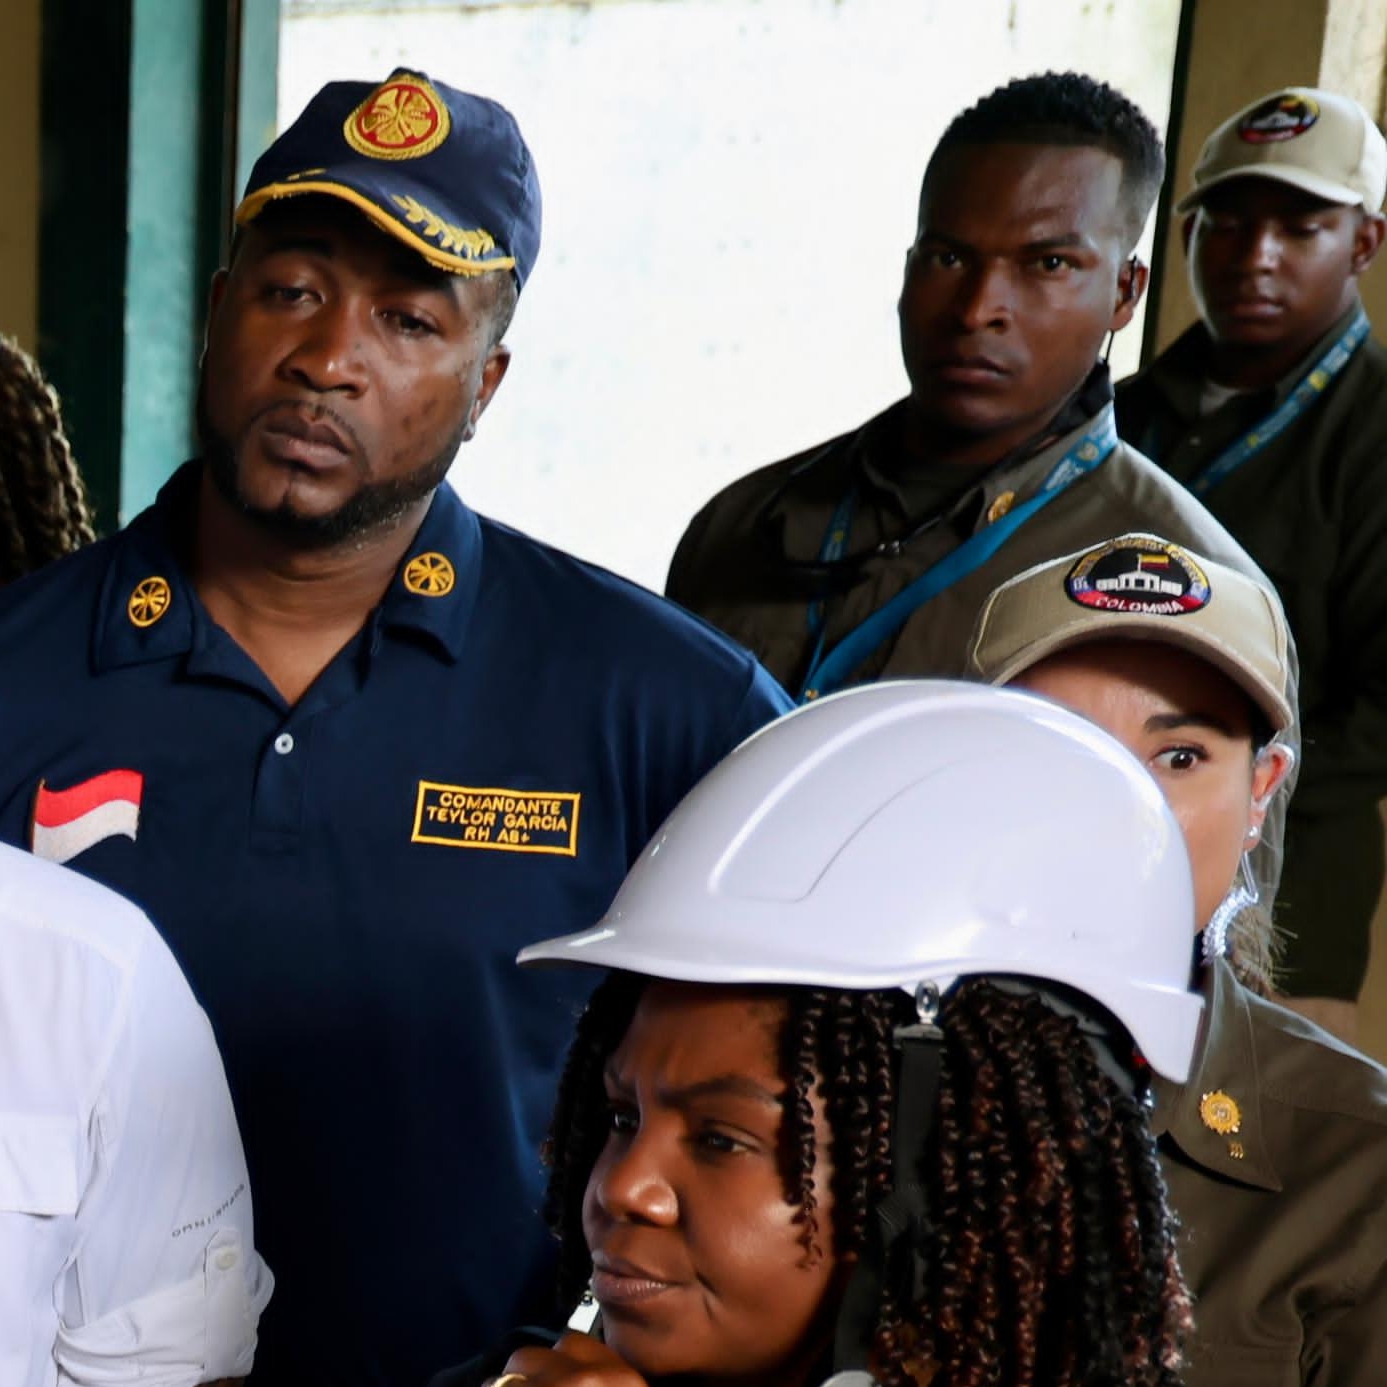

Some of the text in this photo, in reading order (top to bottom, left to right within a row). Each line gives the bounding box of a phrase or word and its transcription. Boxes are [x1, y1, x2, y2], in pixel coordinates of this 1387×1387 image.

[1095, 596, 1185, 614] COLOMBIA
[439, 792, 562, 815] COMANDANTE
[427, 806, 496, 827] TEYLOR
[464, 826, 531, 844] RH AB+
